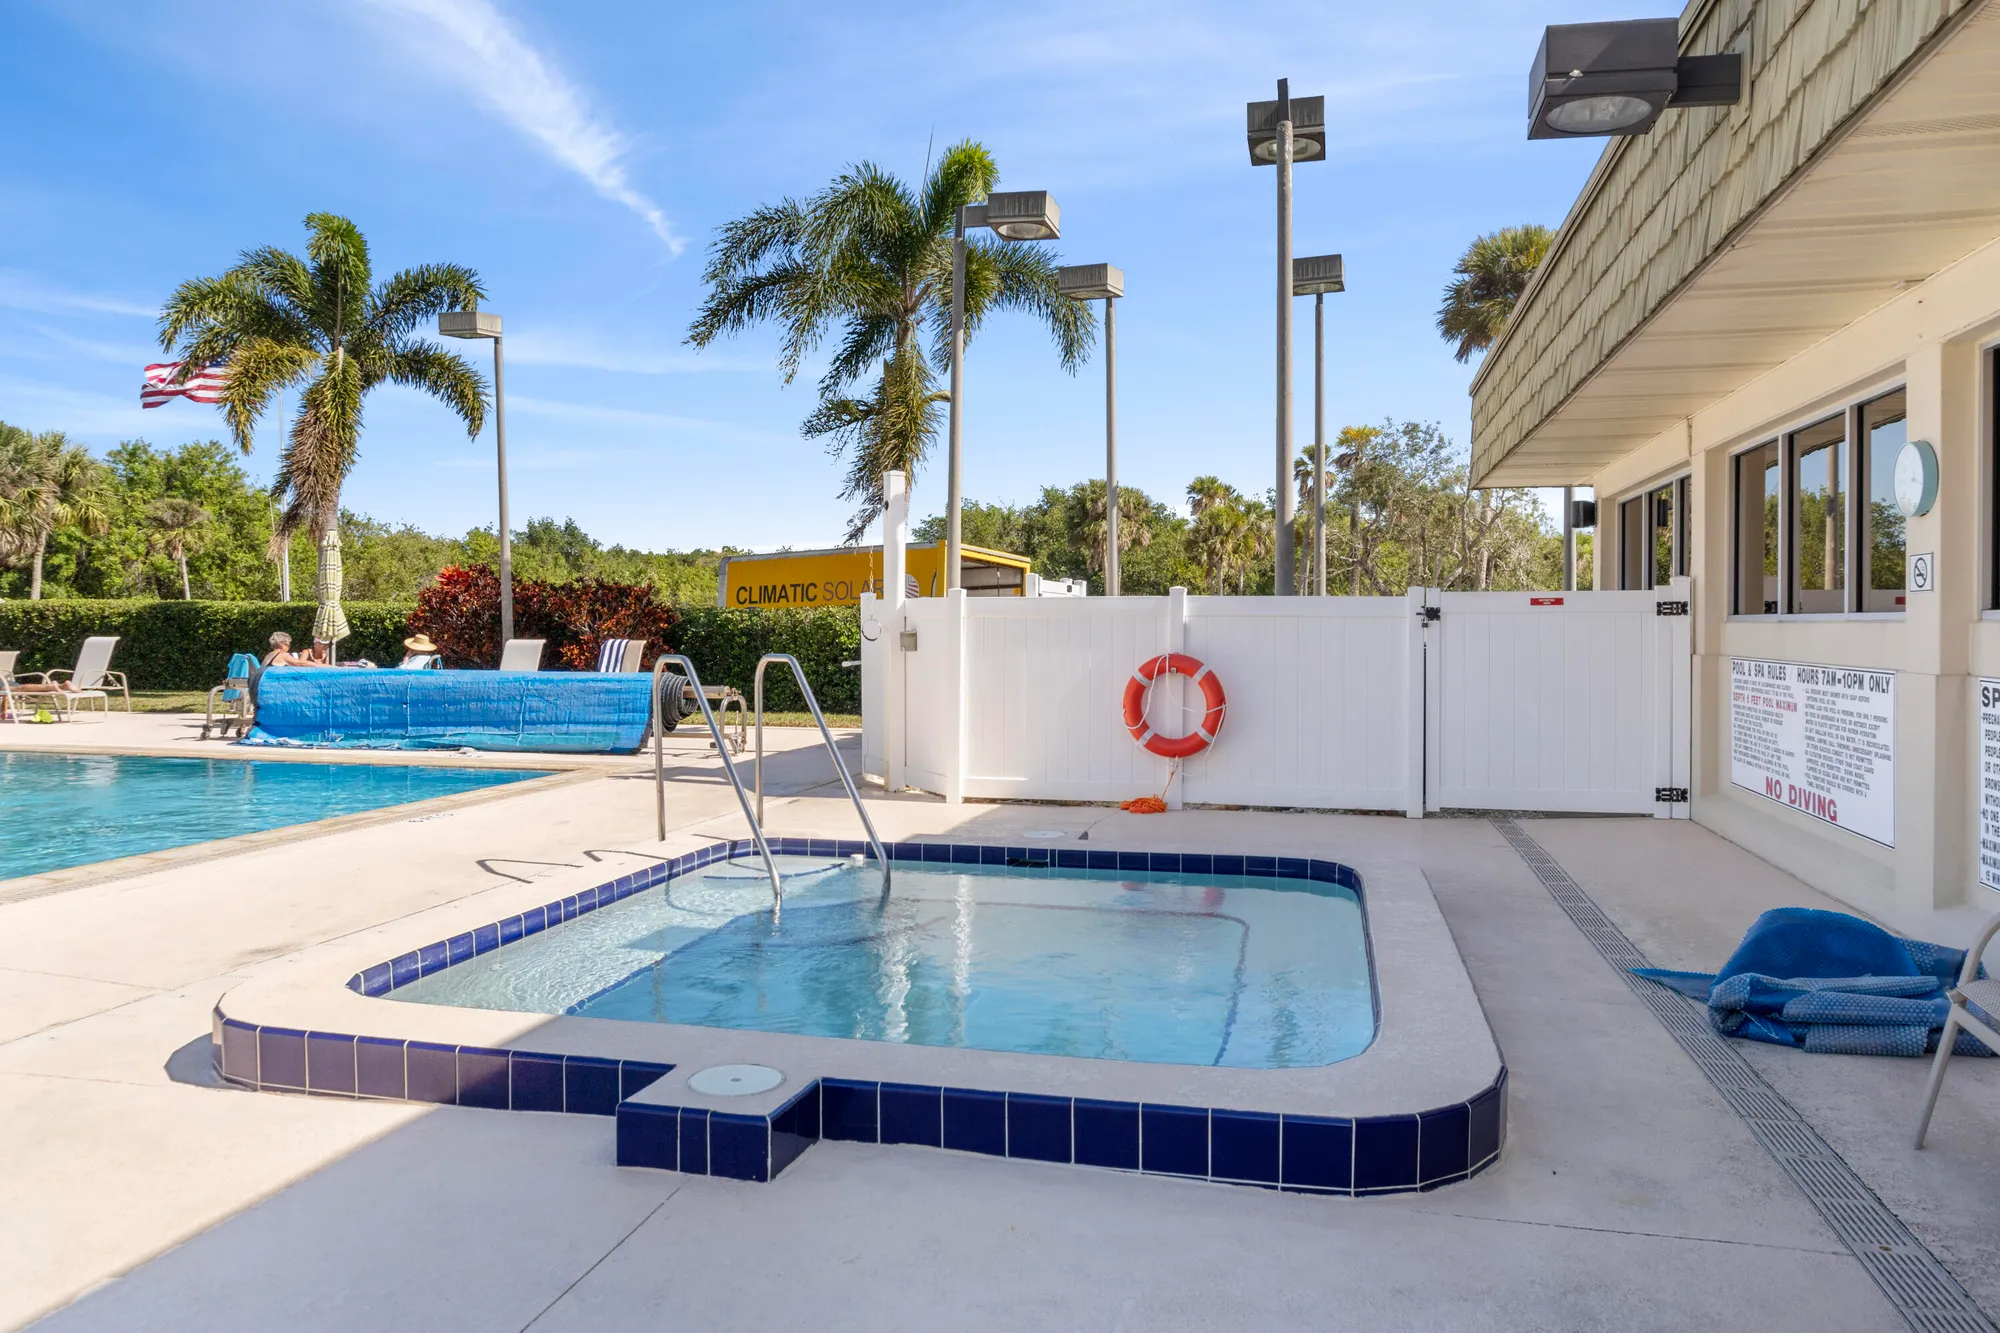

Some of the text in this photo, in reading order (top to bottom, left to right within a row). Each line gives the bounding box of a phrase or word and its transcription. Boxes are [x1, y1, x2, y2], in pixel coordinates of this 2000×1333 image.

[736, 582, 818, 604] CLIMATIC
[1732, 661, 1786, 682] POOL & SPA RULES
[1797, 668, 1820, 686] HOURS
[1869, 674, 1891, 694] ONLY
[1766, 776, 1837, 822] NO DIVING
